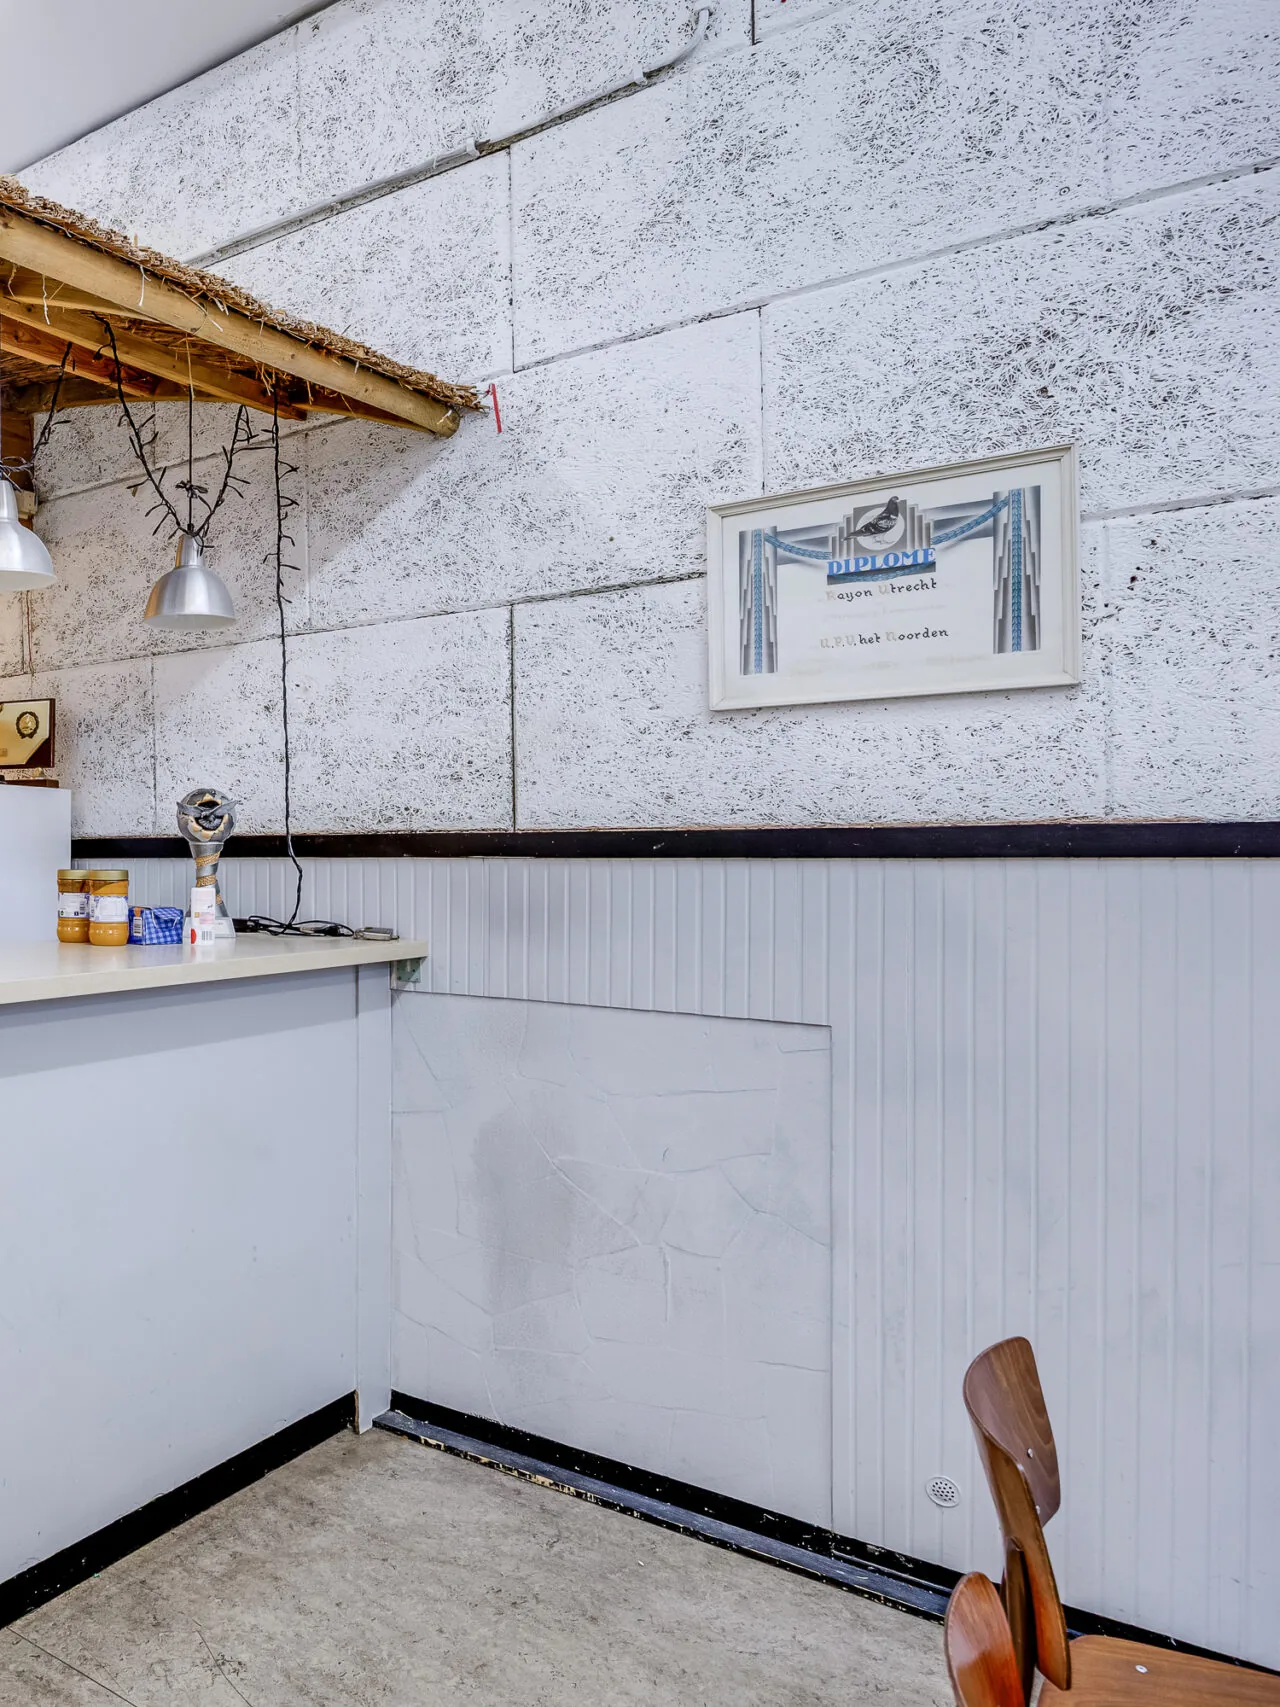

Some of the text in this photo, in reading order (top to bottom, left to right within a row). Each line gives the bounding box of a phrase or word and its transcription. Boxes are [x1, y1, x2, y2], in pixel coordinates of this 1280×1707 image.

[827, 548, 936, 575] DIPLOME
[826, 578, 937, 602] Rayon Utrecht
[859, 633, 880, 645] het
[886, 627, 949, 642] Noorden
